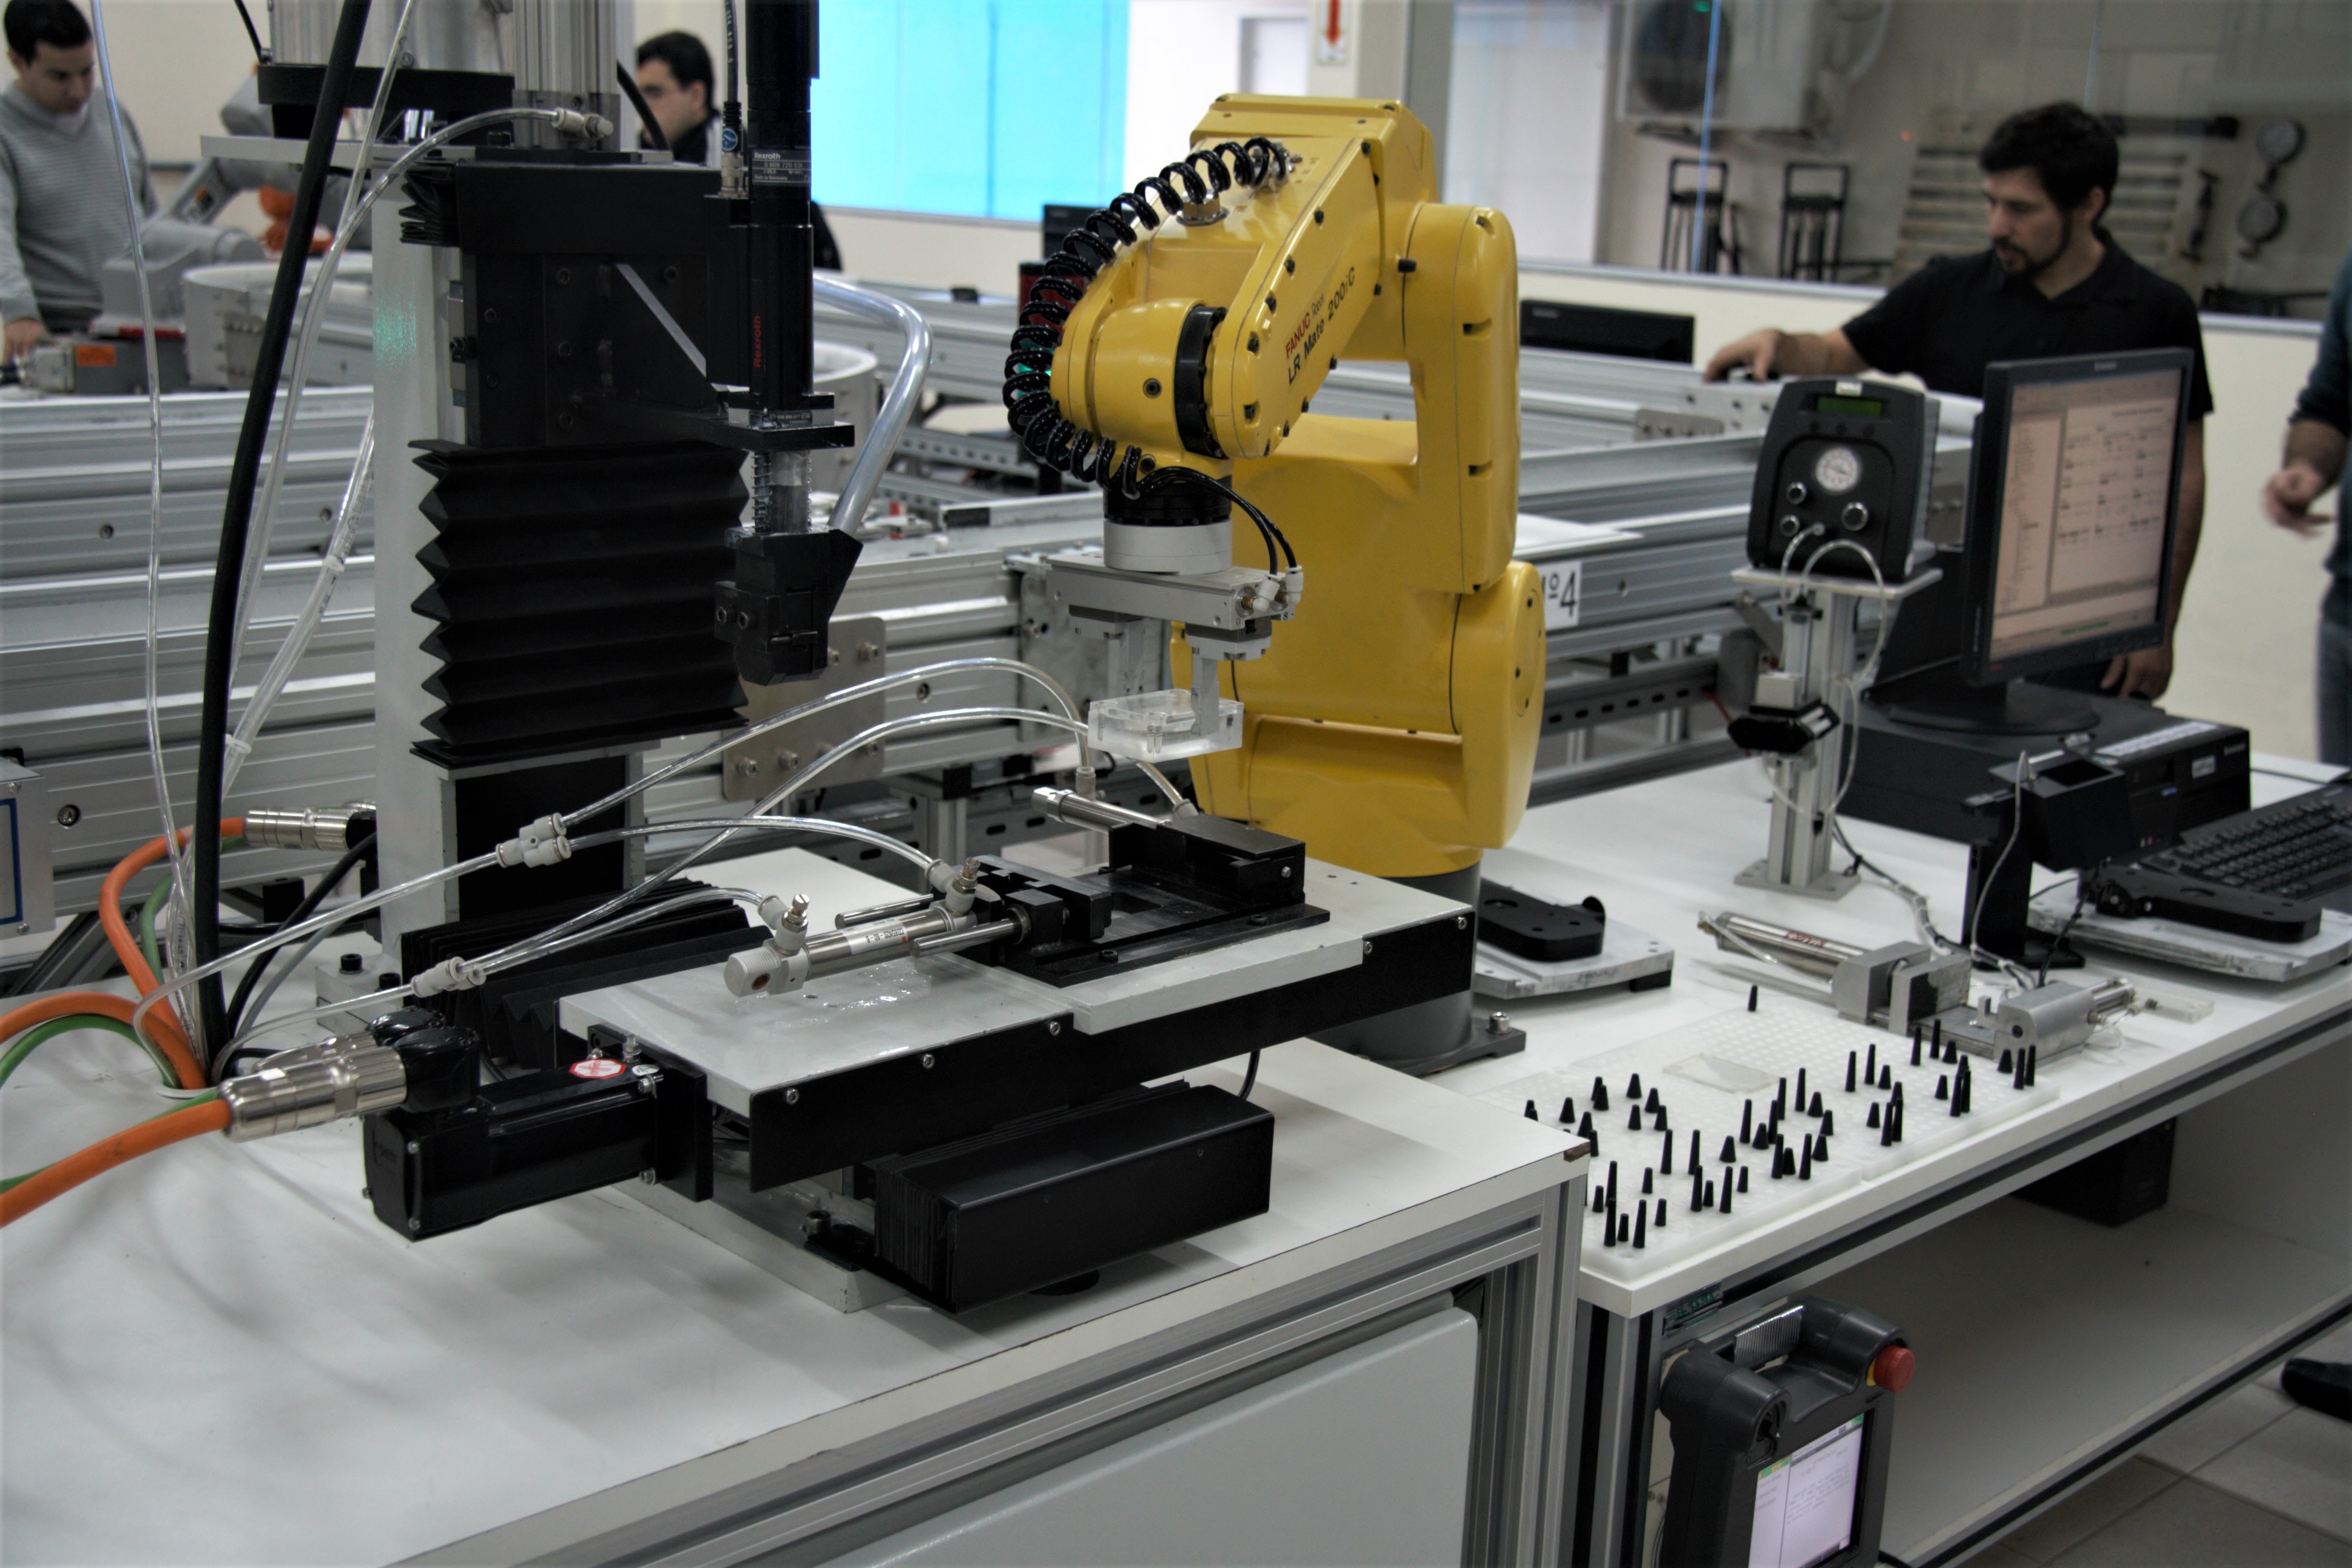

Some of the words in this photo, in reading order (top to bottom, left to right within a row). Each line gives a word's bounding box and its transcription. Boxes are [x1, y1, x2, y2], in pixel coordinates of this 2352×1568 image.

[1285, 312, 1311, 359] FANUC
[1289, 356, 1301, 385] LR
[1304, 319, 1325, 359] Mate
[1328, 266, 1355, 321] 200iC
